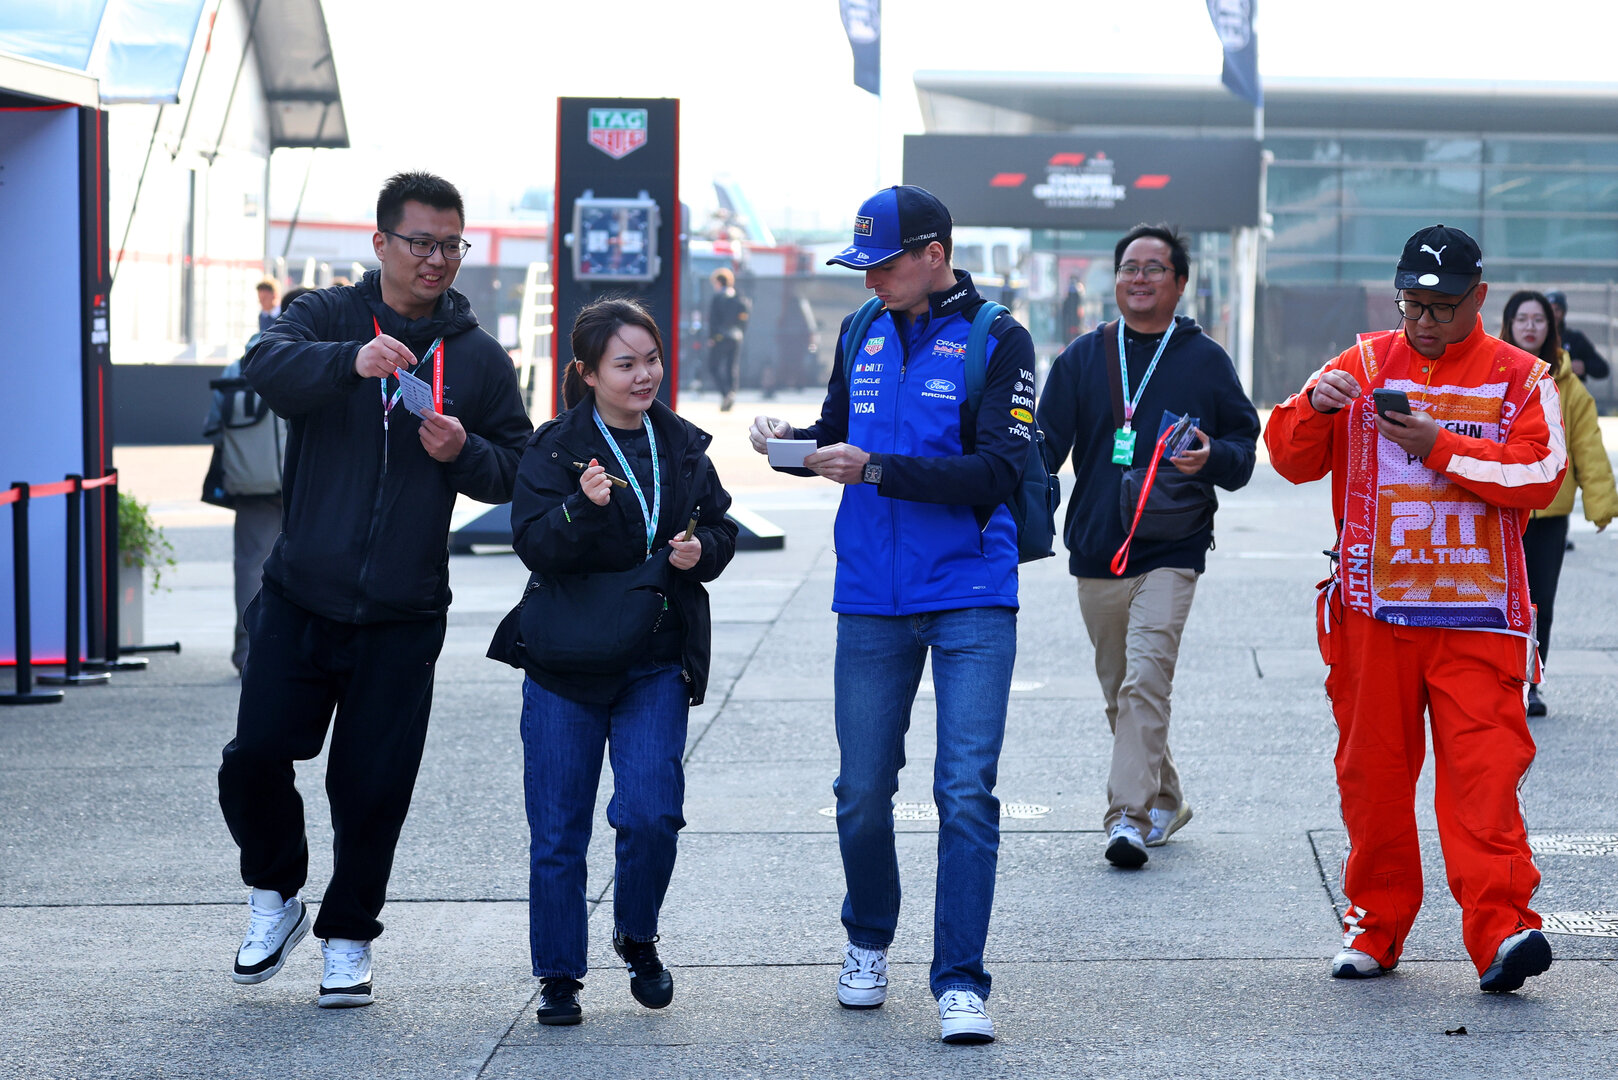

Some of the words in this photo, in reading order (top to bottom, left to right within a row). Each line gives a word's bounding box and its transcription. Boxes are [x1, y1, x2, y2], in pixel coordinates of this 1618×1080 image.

[594, 111, 642, 129] TAG
[903, 232, 938, 244] ALPHATAURI
[856, 364, 874, 372] Mobil
[930, 381, 950, 391] Ford
[921, 392, 957, 401] RACING
[853, 402, 875, 414] VISA
[1362, 394, 1374, 430] 2026
[1390, 501, 1487, 546] PIT
[1390, 549, 1433, 564] ALL
[1511, 592, 1524, 626] 2026
